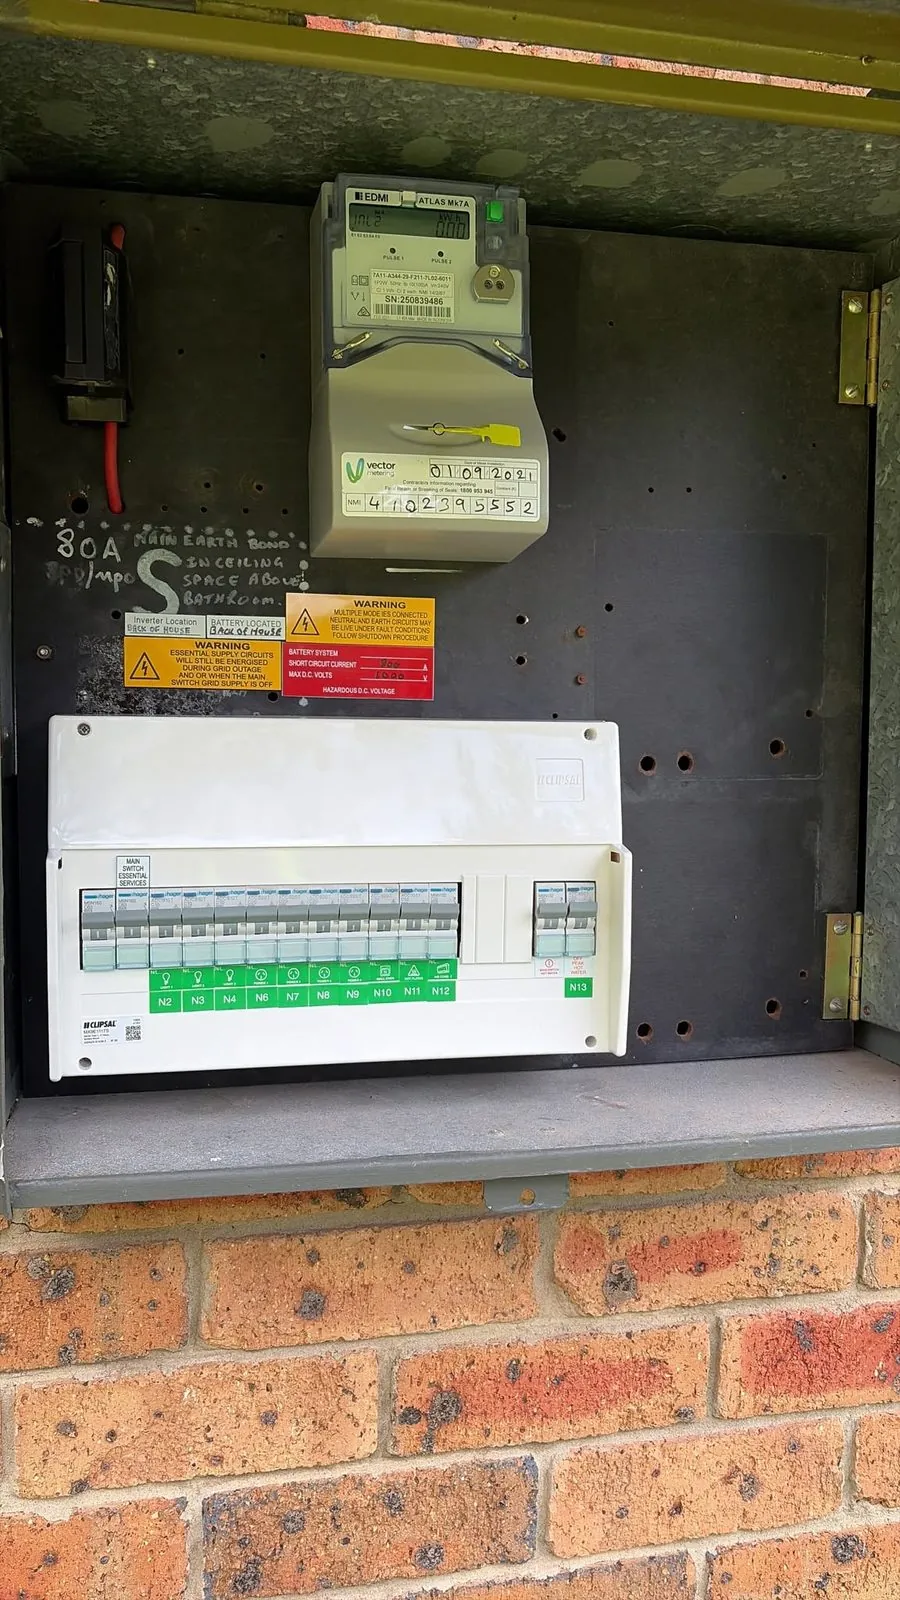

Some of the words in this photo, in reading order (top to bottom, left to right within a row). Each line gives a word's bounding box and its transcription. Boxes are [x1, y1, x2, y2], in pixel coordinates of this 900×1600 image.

[365, 193, 389, 202] EDMI
[419, 197, 445, 205] ATLAS
[448, 199, 469, 208] Mk7A
[385, 295, 444, 305] SN:250839486
[366, 461, 395, 470] vector
[366, 470, 395, 478] metering
[183, 535, 238, 548] EARTH
[248, 538, 290, 550] BOND
[186, 556, 210, 568] IN
[215, 557, 284, 569] CEILING
[183, 574, 239, 587] SPACE
[354, 600, 406, 609] WARNING
[334, 609, 362, 617] MULTIPLE
[134, 616, 163, 625] Inverter
[166, 618, 197, 626] Location
[211, 619, 244, 627] BATTERY
[246, 620, 281, 628] LOCATED
[127, 624, 146, 632] BACK
[210, 626, 234, 635] BACK
[195, 642, 250, 650] WARNING
[288, 648, 314, 656] BATTERY
[432, 987, 450, 995] N12
[570, 983, 587, 991] N13
[256, 993, 268, 1002] N6
[286, 992, 299, 1001] N7
[317, 991, 330, 1000] N8
[346, 990, 359, 999] N9
[374, 989, 392, 997] N10
[158, 998, 172, 1006] N2
[192, 996, 204, 1005] N3
[224, 995, 236, 1004] N4
[90, 1020, 116, 1028] CLIPSAL
